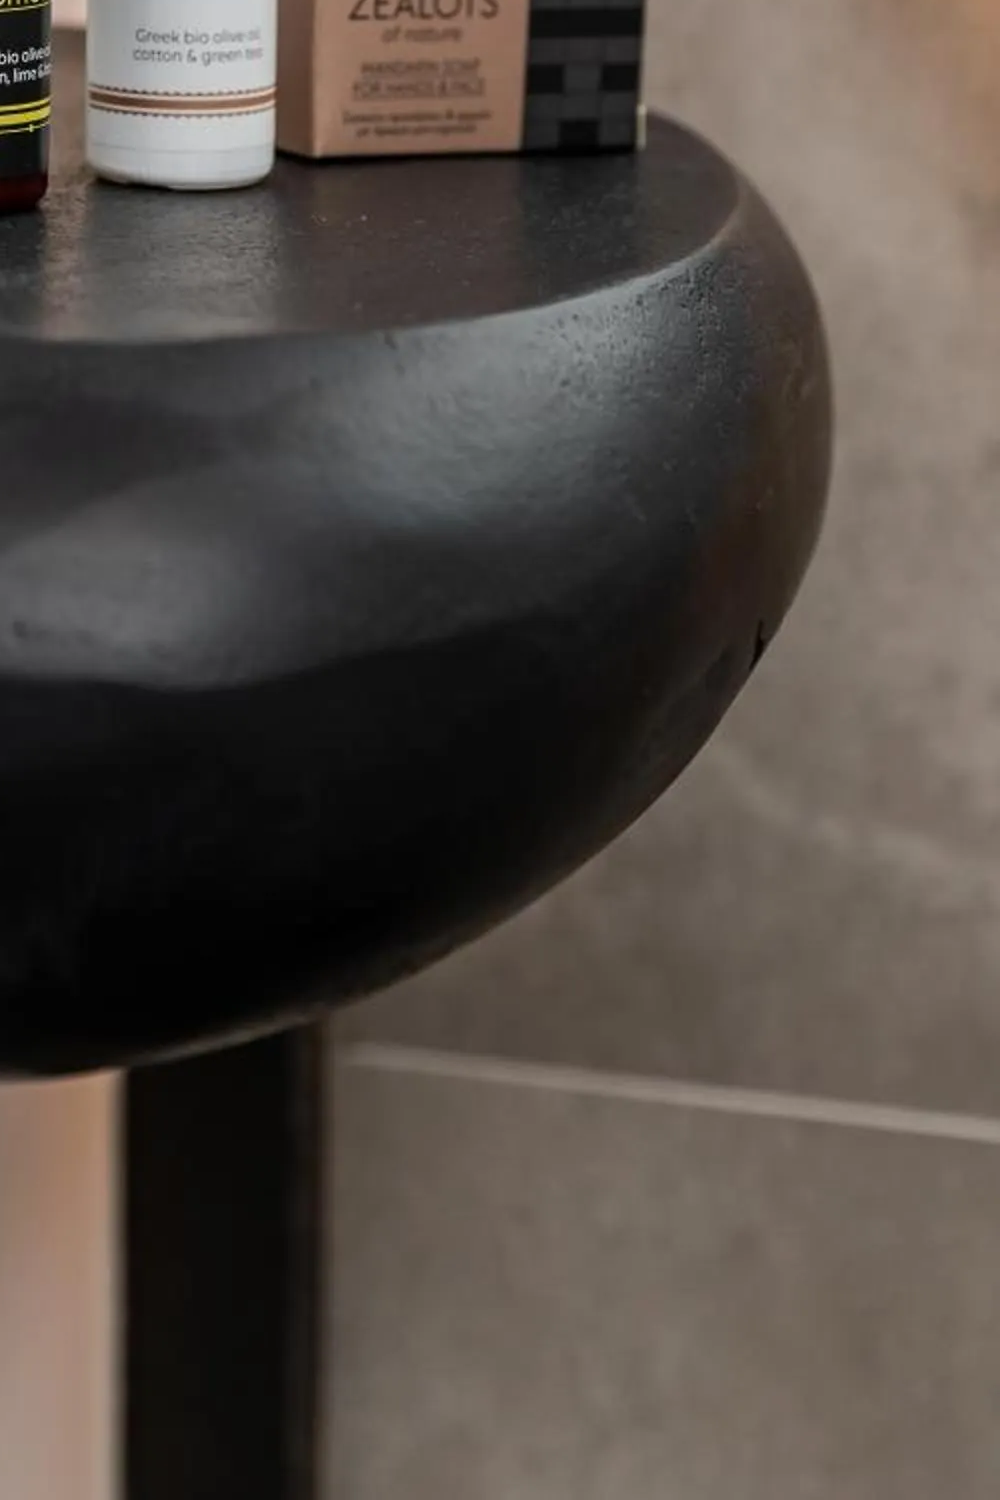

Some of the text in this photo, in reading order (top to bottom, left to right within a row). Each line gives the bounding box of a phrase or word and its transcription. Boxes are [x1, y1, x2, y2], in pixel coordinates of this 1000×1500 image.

[135, 27, 180, 44] Greek
[184, 29, 210, 45] bio
[212, 28, 245, 44] olive
[381, 25, 462, 43] of nature
[132, 47, 182, 63] cotton
[186, 48, 197, 64] &
[201, 48, 244, 67] green
[13, 66, 37, 83] lime
